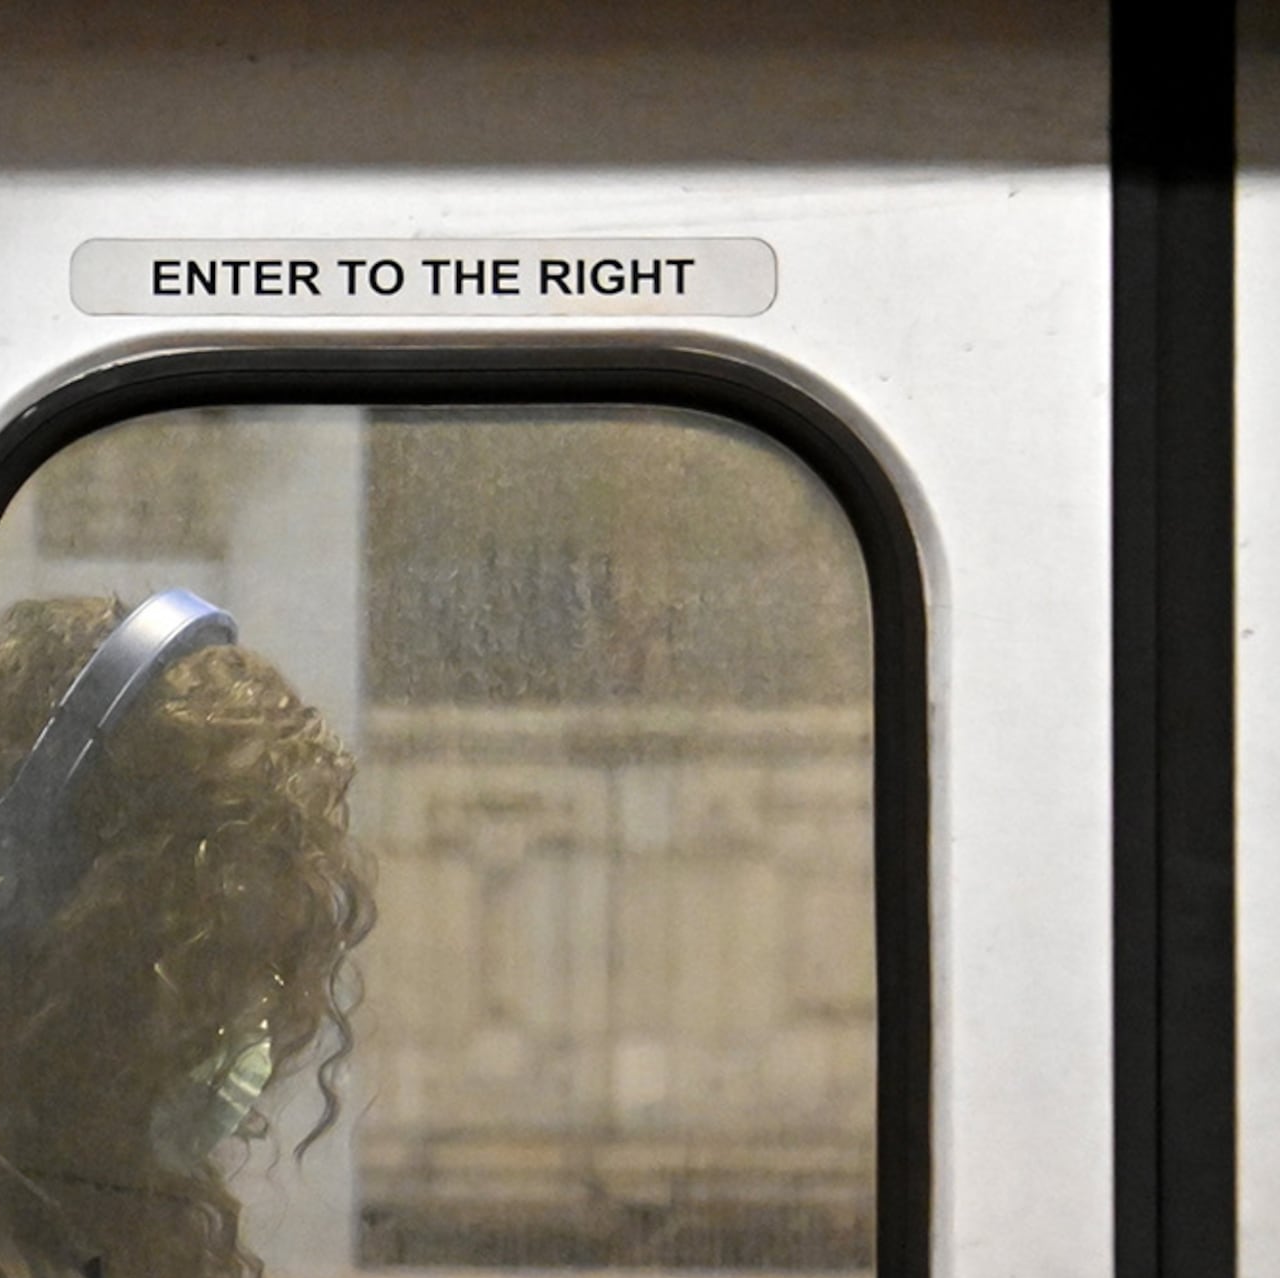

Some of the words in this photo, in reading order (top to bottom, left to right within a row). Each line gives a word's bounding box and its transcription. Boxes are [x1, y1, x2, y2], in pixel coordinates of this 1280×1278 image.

[153, 260, 321, 296] ENTER
[337, 259, 405, 296] TO
[421, 259, 520, 295] THE
[540, 258, 695, 295] RIGHT
